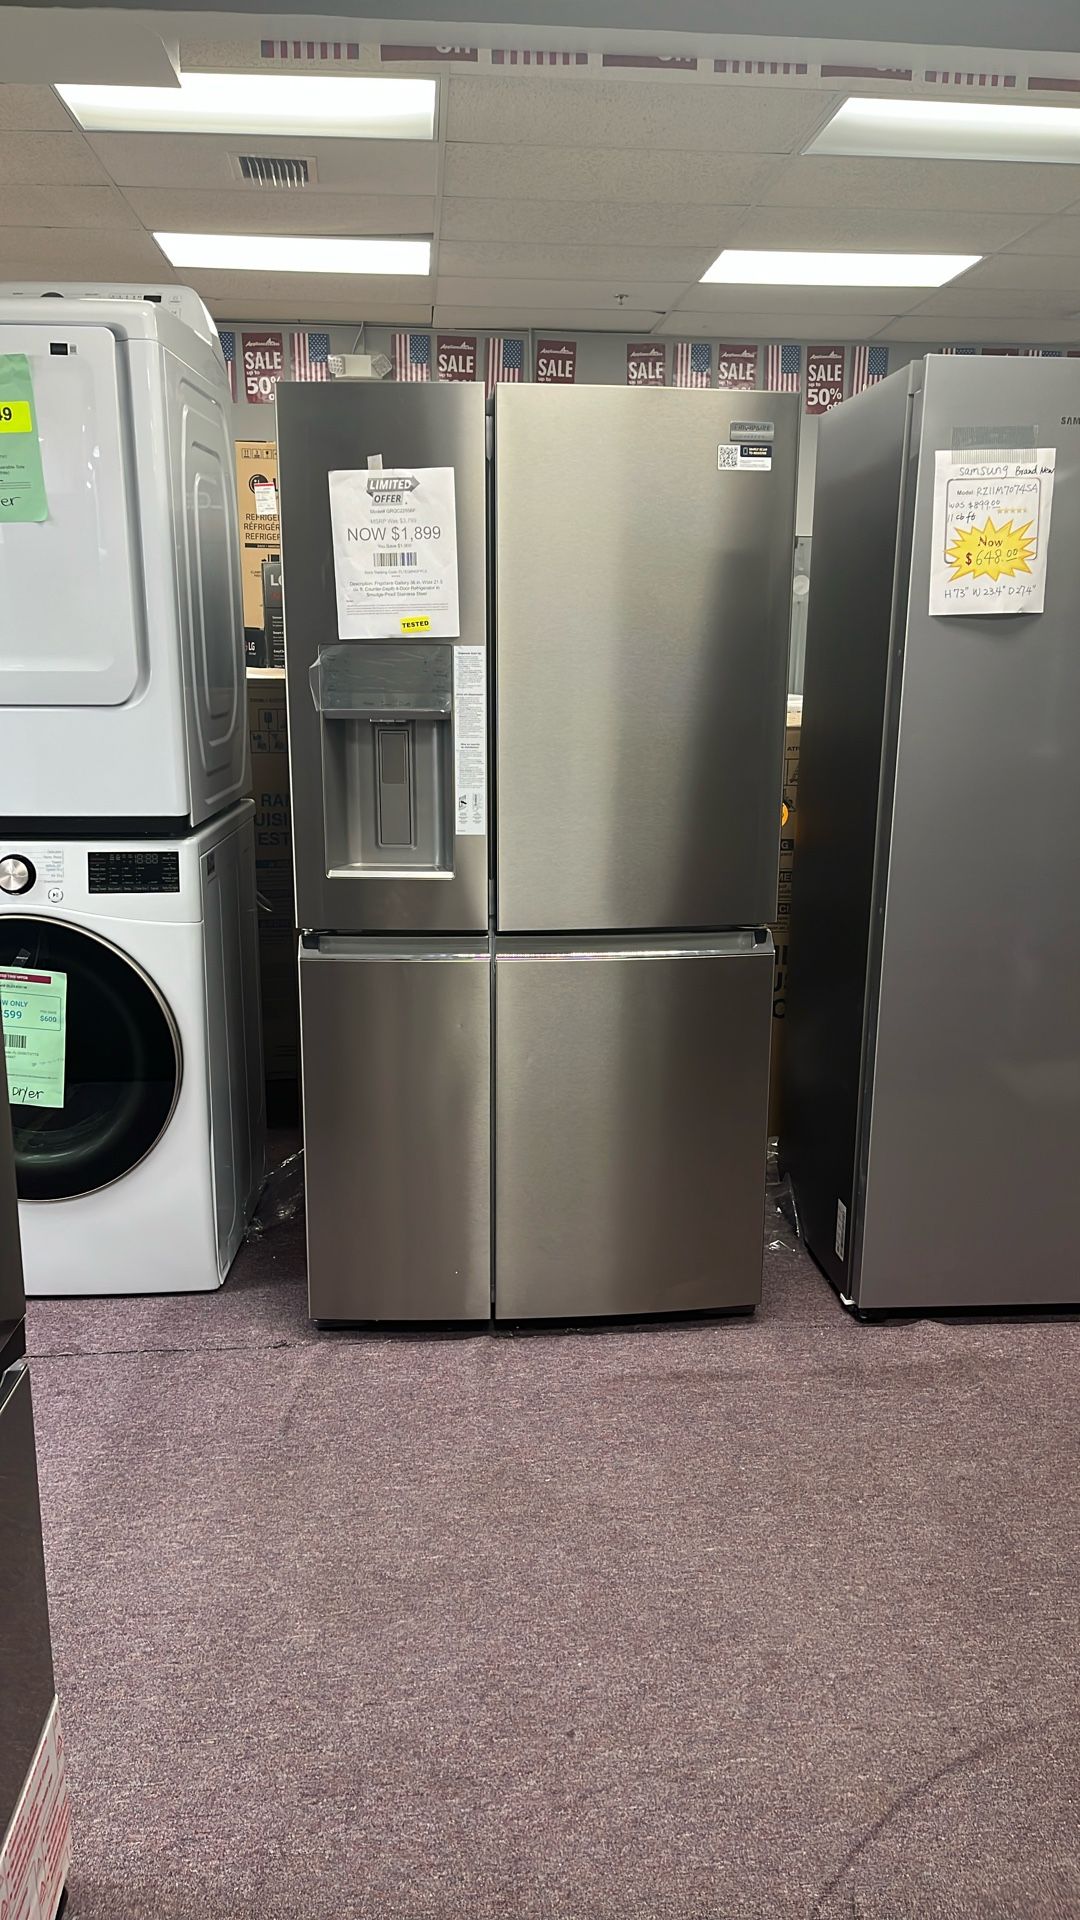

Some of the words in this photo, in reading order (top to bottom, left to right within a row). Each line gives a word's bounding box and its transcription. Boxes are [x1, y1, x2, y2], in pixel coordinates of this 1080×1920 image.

[245, 352, 282, 370] SALE
[438, 354, 474, 373] SALE
[537, 358, 573, 378] SALE
[628, 362, 663, 379] SALE
[719, 362, 754, 380] SALE
[808, 364, 842, 382] SALE
[807, 388, 842, 406] 50%
[1015, 465, 1038, 476] Brand
[1039, 466, 1056, 474] New
[369, 479, 413, 490] LIMITED
[373, 494, 402, 504] OFFER
[347, 527, 387, 541] NOW
[391, 525, 441, 542] $1,899
[977, 536, 1004, 547] Now
[402, 620, 430, 629] TESTED
[248, 642, 256, 651] LG
